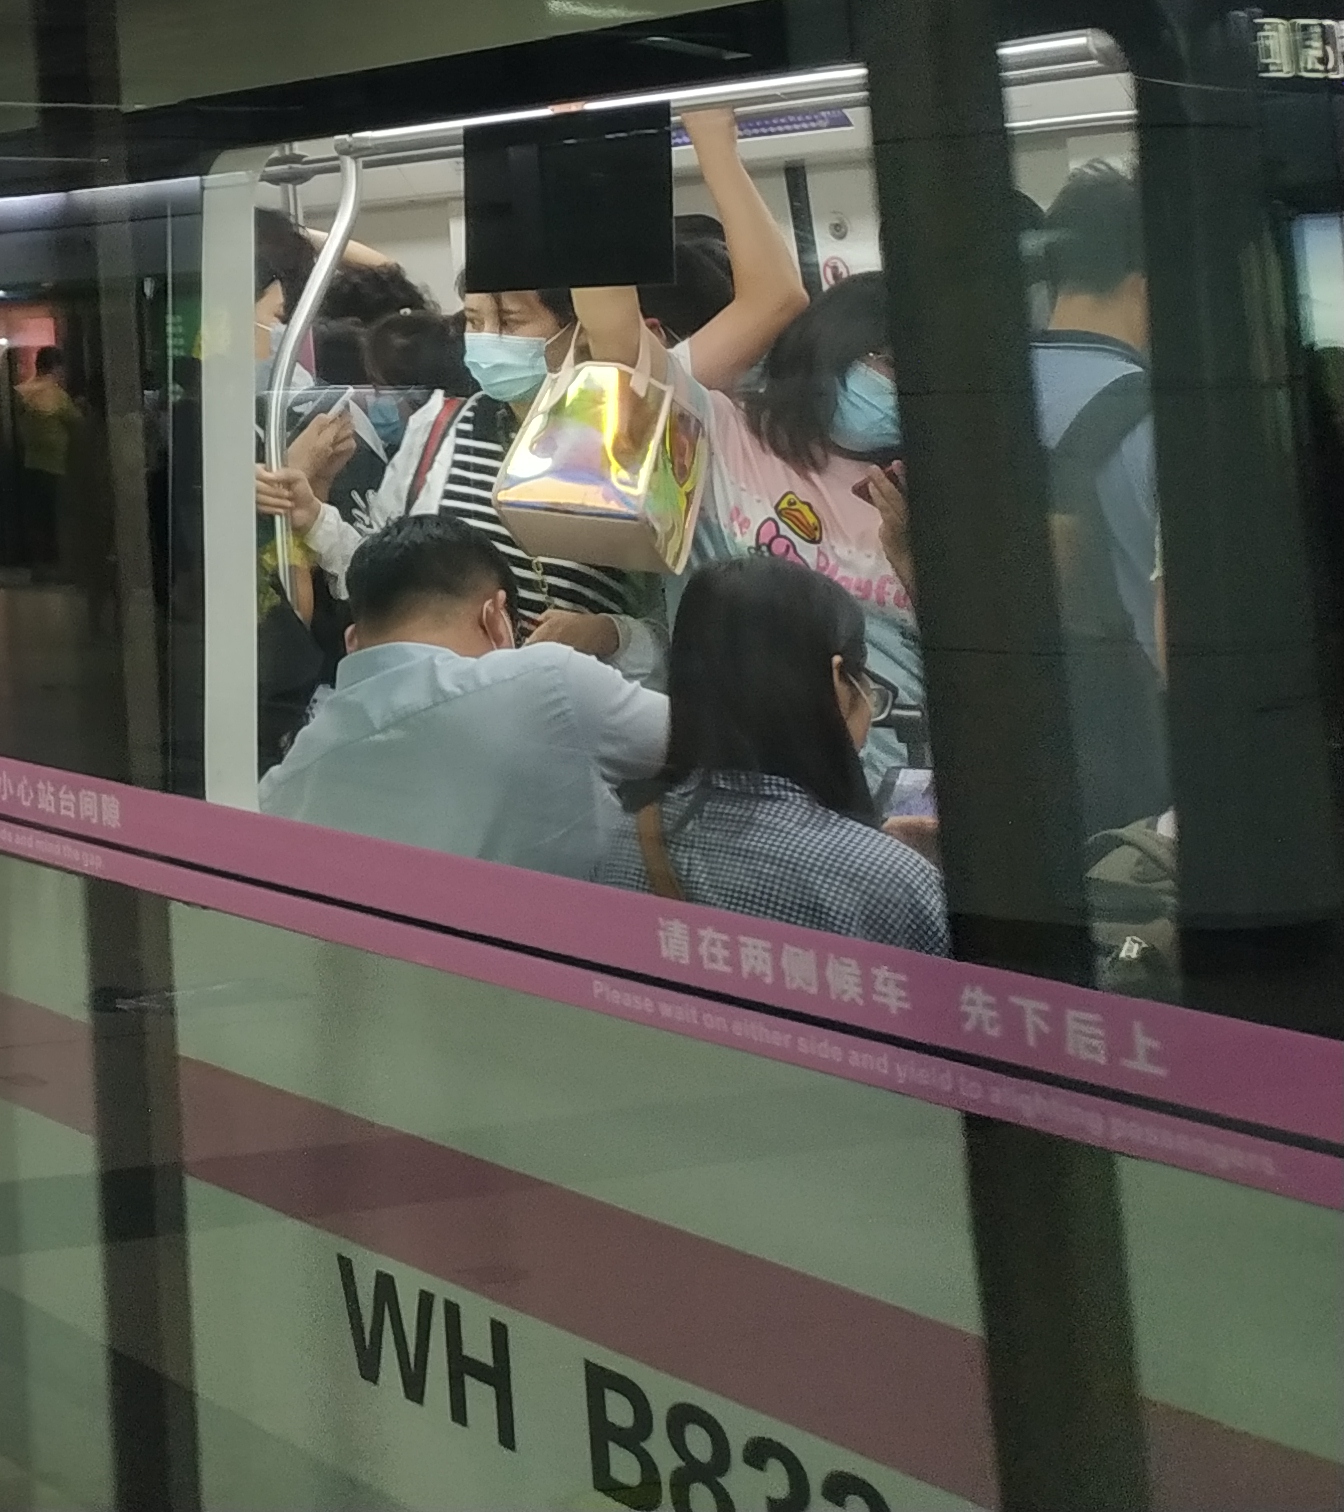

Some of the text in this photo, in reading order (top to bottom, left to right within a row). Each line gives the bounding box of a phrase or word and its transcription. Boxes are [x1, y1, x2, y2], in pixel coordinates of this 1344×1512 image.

[14, 830, 35, 847] and
[62, 844, 81, 860] the
[592, 979, 655, 1013] Please
[660, 1001, 699, 1025] wait
[702, 1012, 729, 1031] on
[731, 1013, 794, 1050] either
[797, 1033, 843, 1063] side
[847, 1050, 889, 1075] and
[657, 917, 1169, 1078] 请在两侧候车 先下后上
[336, 1251, 892, 1512] WH B83
